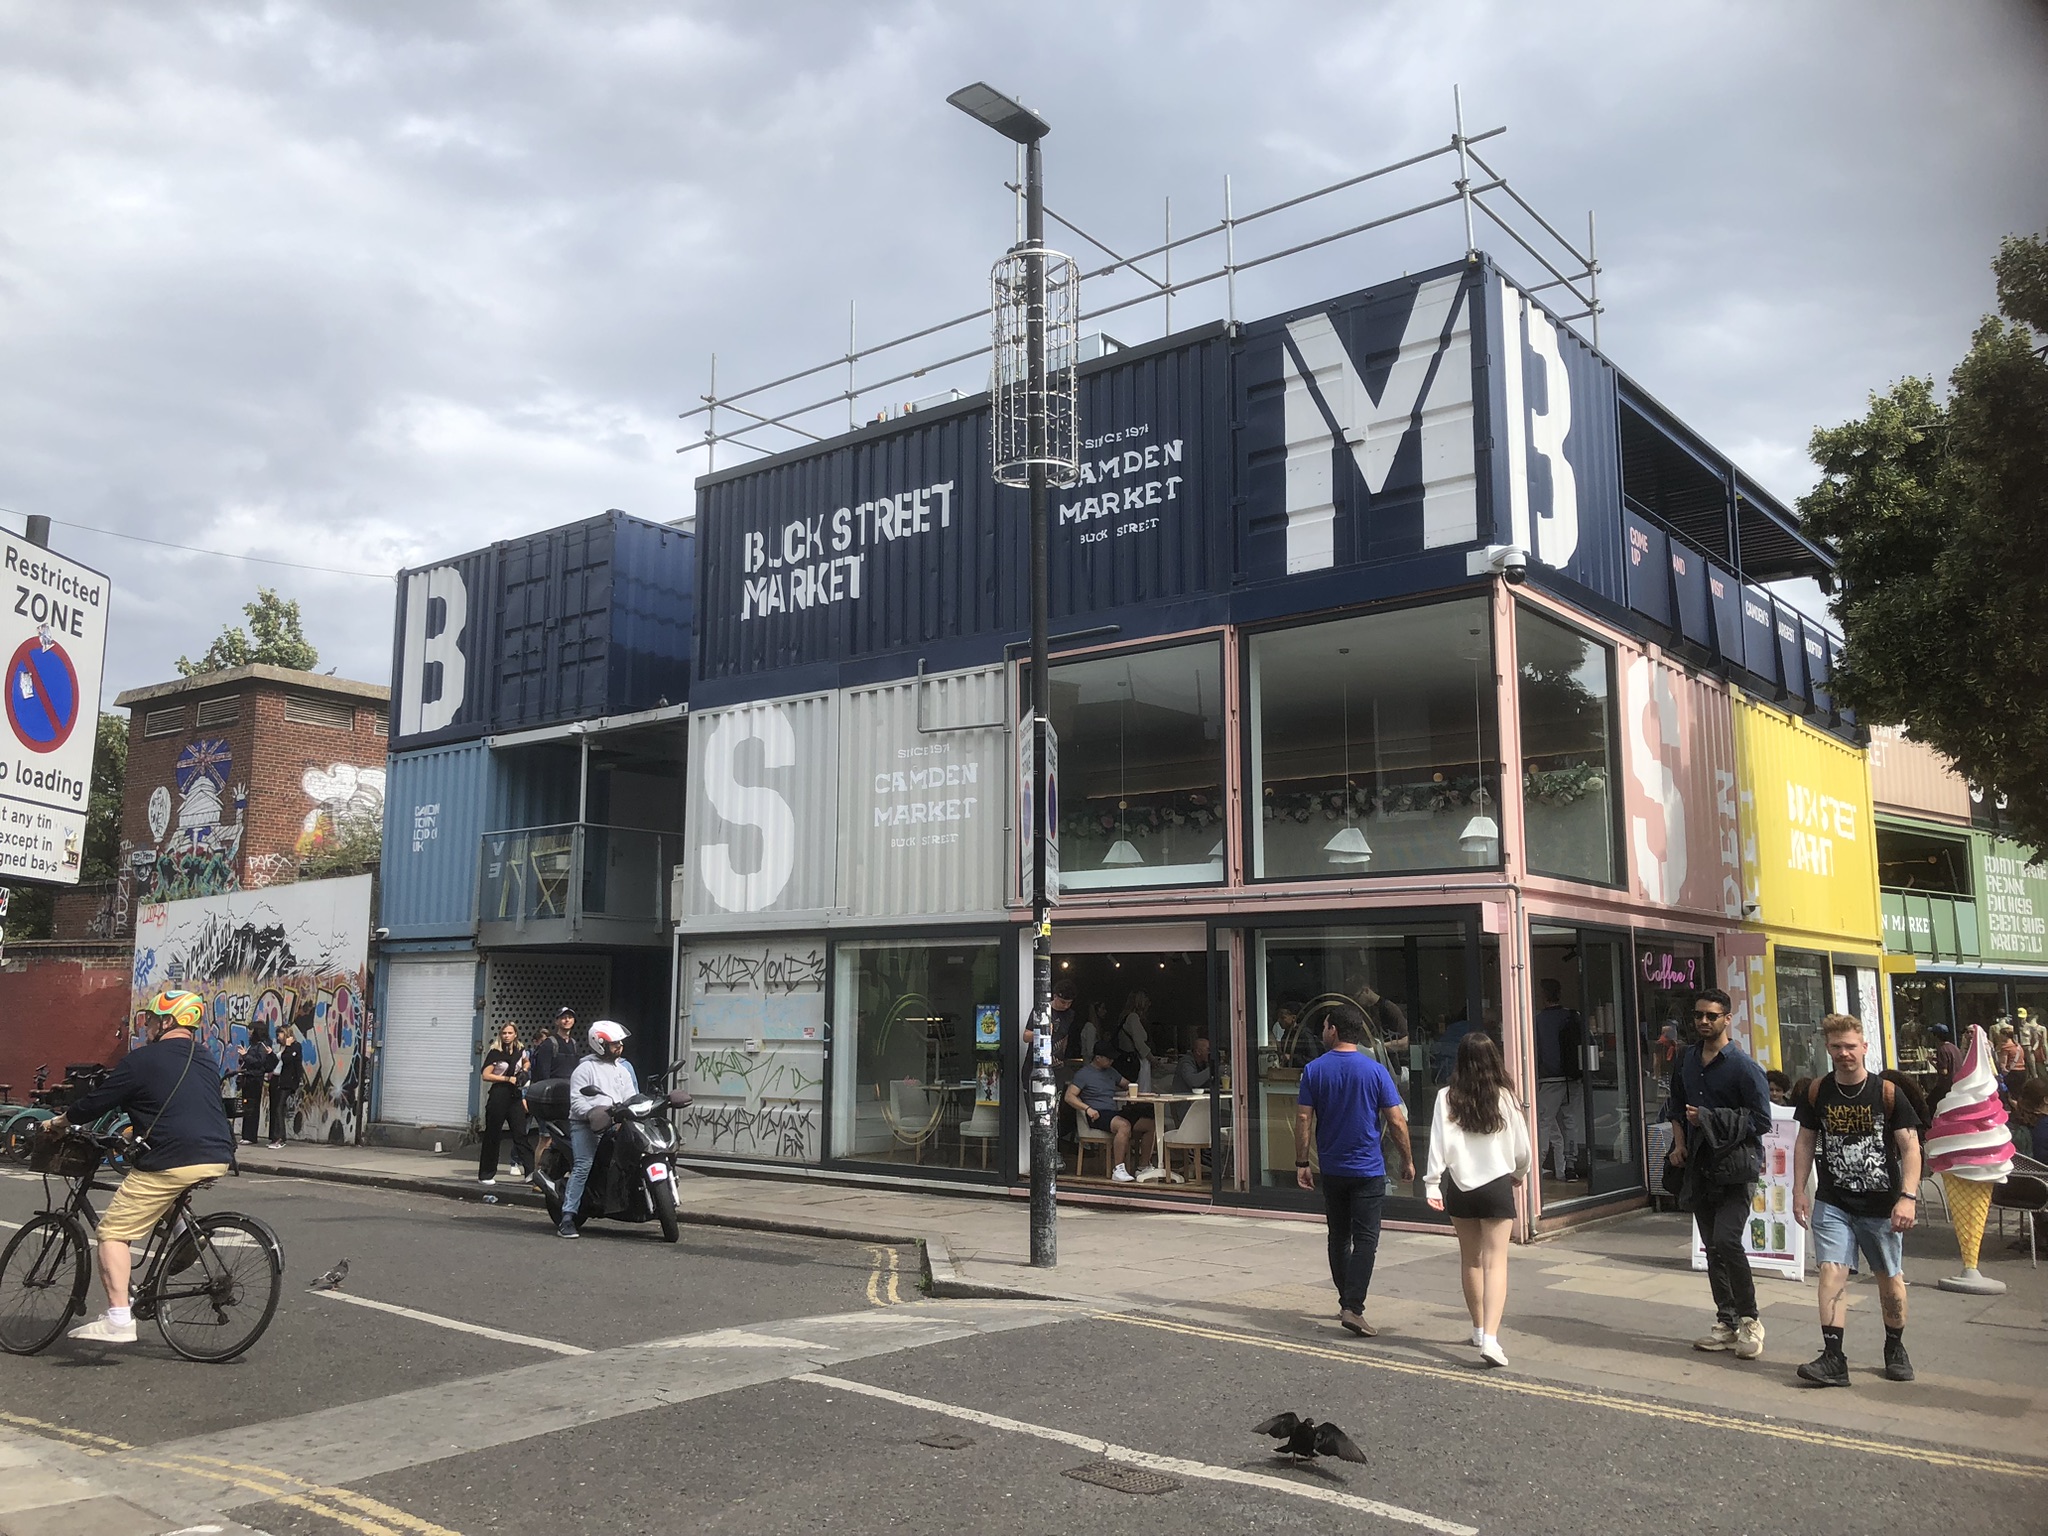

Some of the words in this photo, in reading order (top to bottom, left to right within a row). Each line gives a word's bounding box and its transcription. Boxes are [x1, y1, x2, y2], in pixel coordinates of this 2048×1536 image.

[1283, 271, 1478, 575] M
[1501, 276, 1579, 570] B
[1085, 432, 1122, 449] SINCE
[1060, 476, 1184, 526] MARKET
[745, 513, 824, 573] BUCK
[832, 480, 954, 551] STREET
[1116, 517, 1160, 537] STREET
[1629, 526, 1649, 553] COME
[1630, 546, 1641, 567] UP
[5, 545, 100, 607] Restricted
[741, 553, 865, 622] MARKET
[14, 585, 84, 639] ZONE
[399, 566, 468, 737] B
[897, 747, 929, 759] SINCE
[16, 760, 83, 801] loading
[875, 763, 978, 794] CAMDEN
[1627, 656, 1688, 907] S
[11, 811, 33, 829] any
[701, 700, 796, 913] S
[874, 798, 978, 827] MARKET
[42, 836, 53, 851] in
[31, 854, 58, 874] bays
[229, 995, 250, 1021] RIP
[1825, 1103, 1873, 1120] NAPALM
[1826, 1115, 1873, 1133] DEATH
[650, 1165, 664, 1177] L
